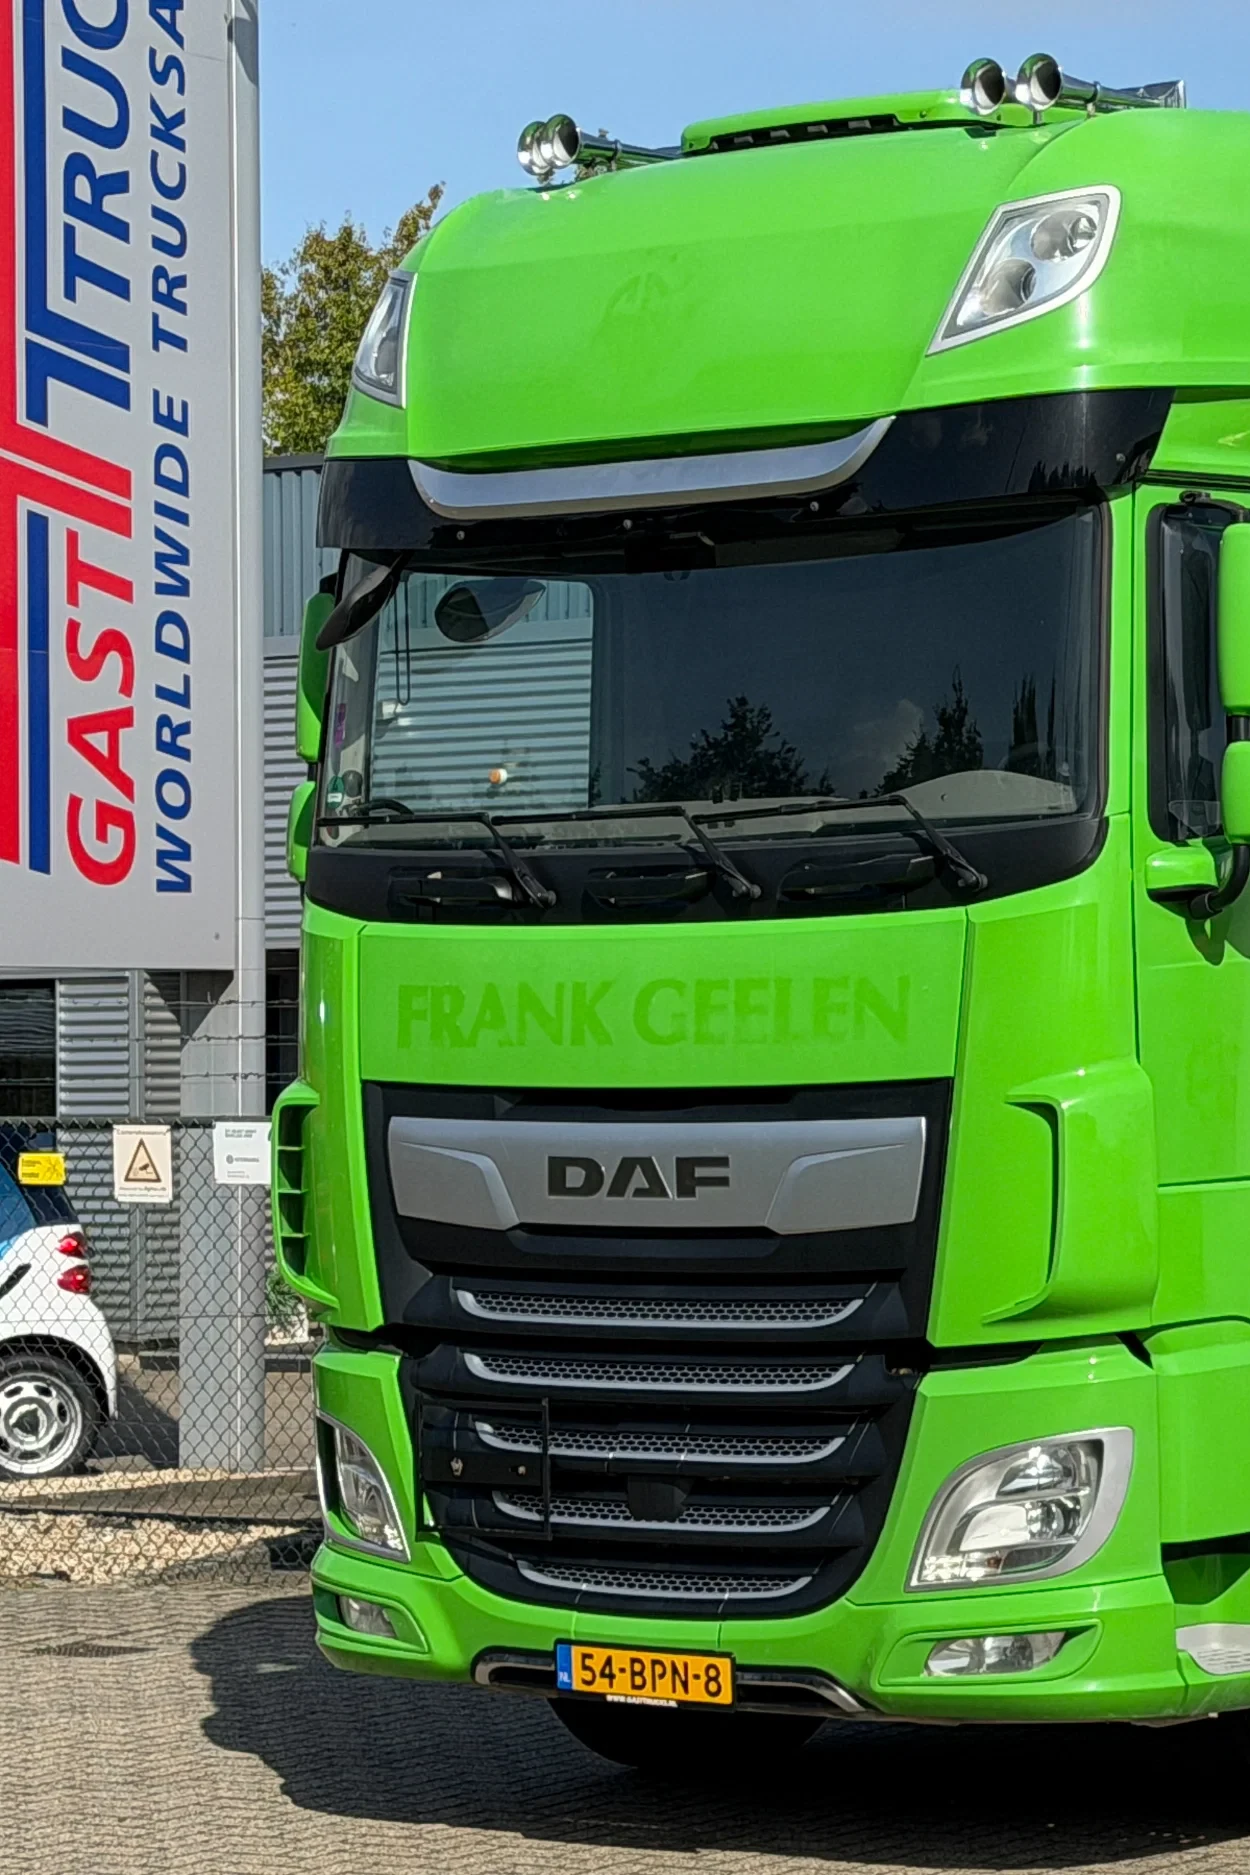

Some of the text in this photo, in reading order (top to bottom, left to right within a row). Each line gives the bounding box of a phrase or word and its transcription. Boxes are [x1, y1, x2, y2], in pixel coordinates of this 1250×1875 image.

[148, 0, 192, 892] WORLDWIDE TRUCKSA
[66, 528, 136, 886] GAST
[397, 974, 911, 1050] FRANK GEELEN
[547, 1155, 730, 1199] DAF
[580, 1652, 723, 1698] 54-BPN-8
